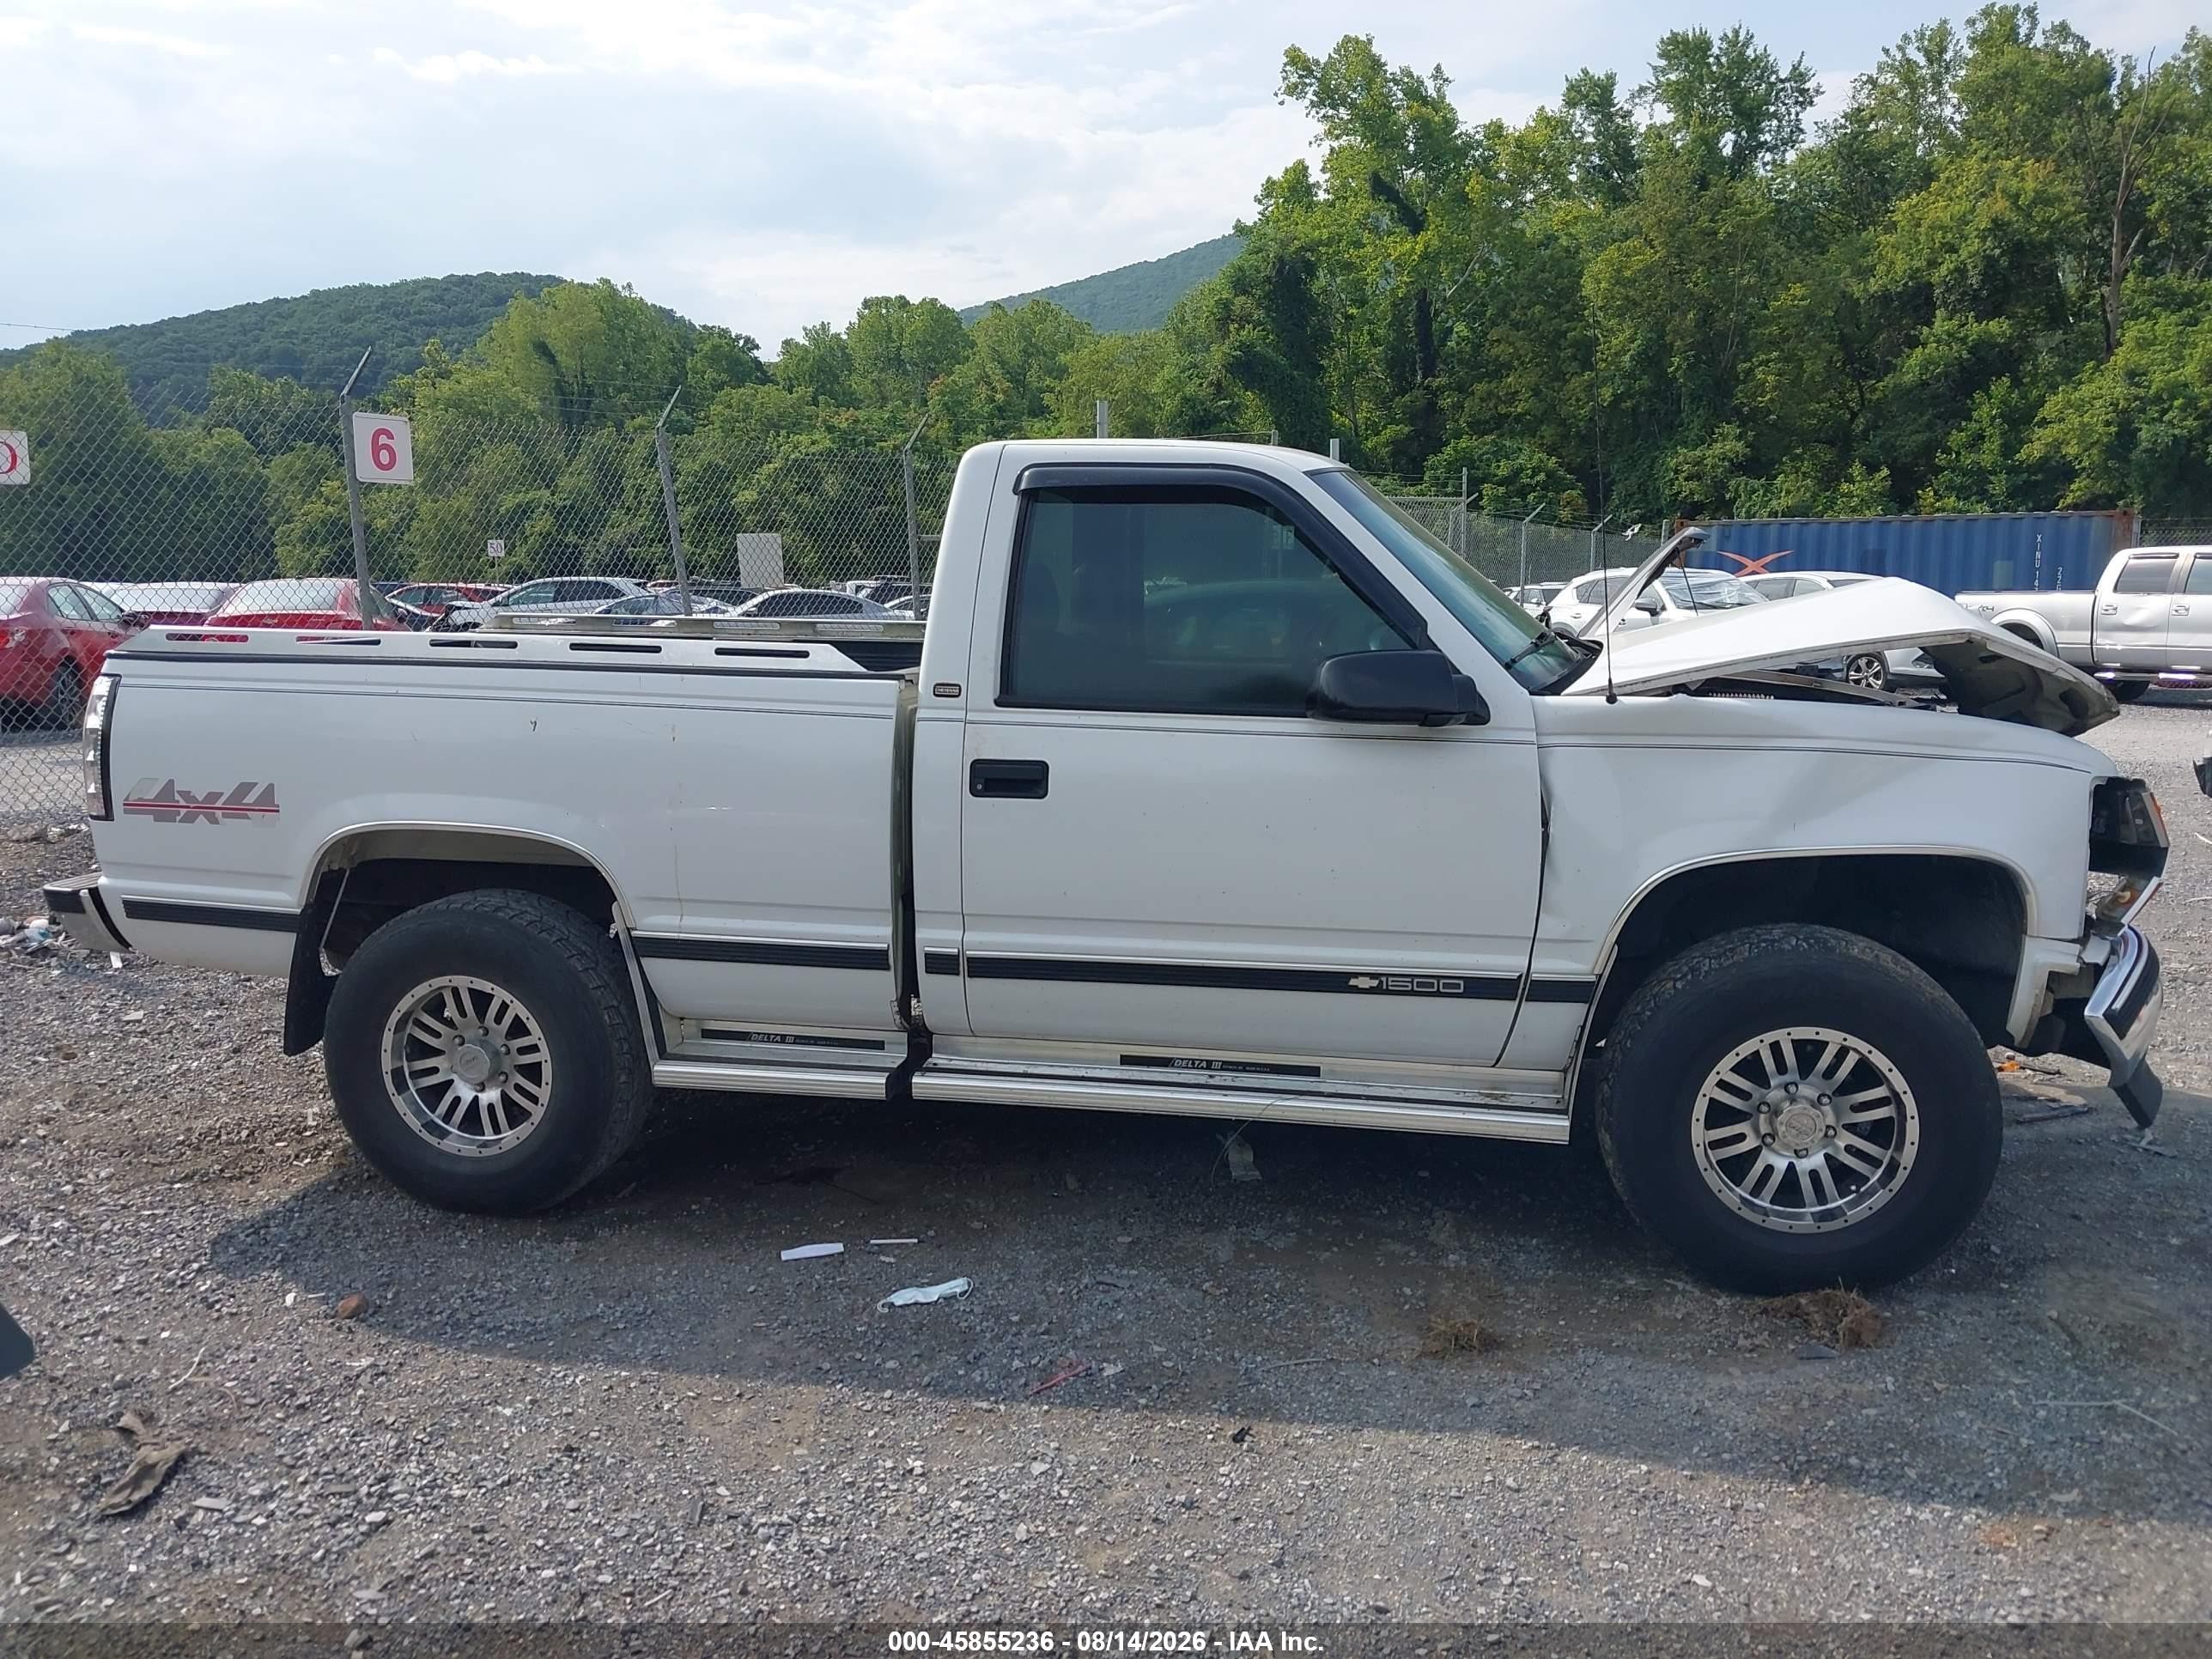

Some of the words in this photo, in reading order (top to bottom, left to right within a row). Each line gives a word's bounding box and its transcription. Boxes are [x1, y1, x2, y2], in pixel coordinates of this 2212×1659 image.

[371, 428, 397, 471] 6
[1380, 976, 1464, 994] 1500
[750, 1033, 781, 1043] DELTA
[785, 1036, 795, 1044] III
[1173, 1059, 1207, 1069] DELTA
[1211, 1061, 1224, 1070] III
